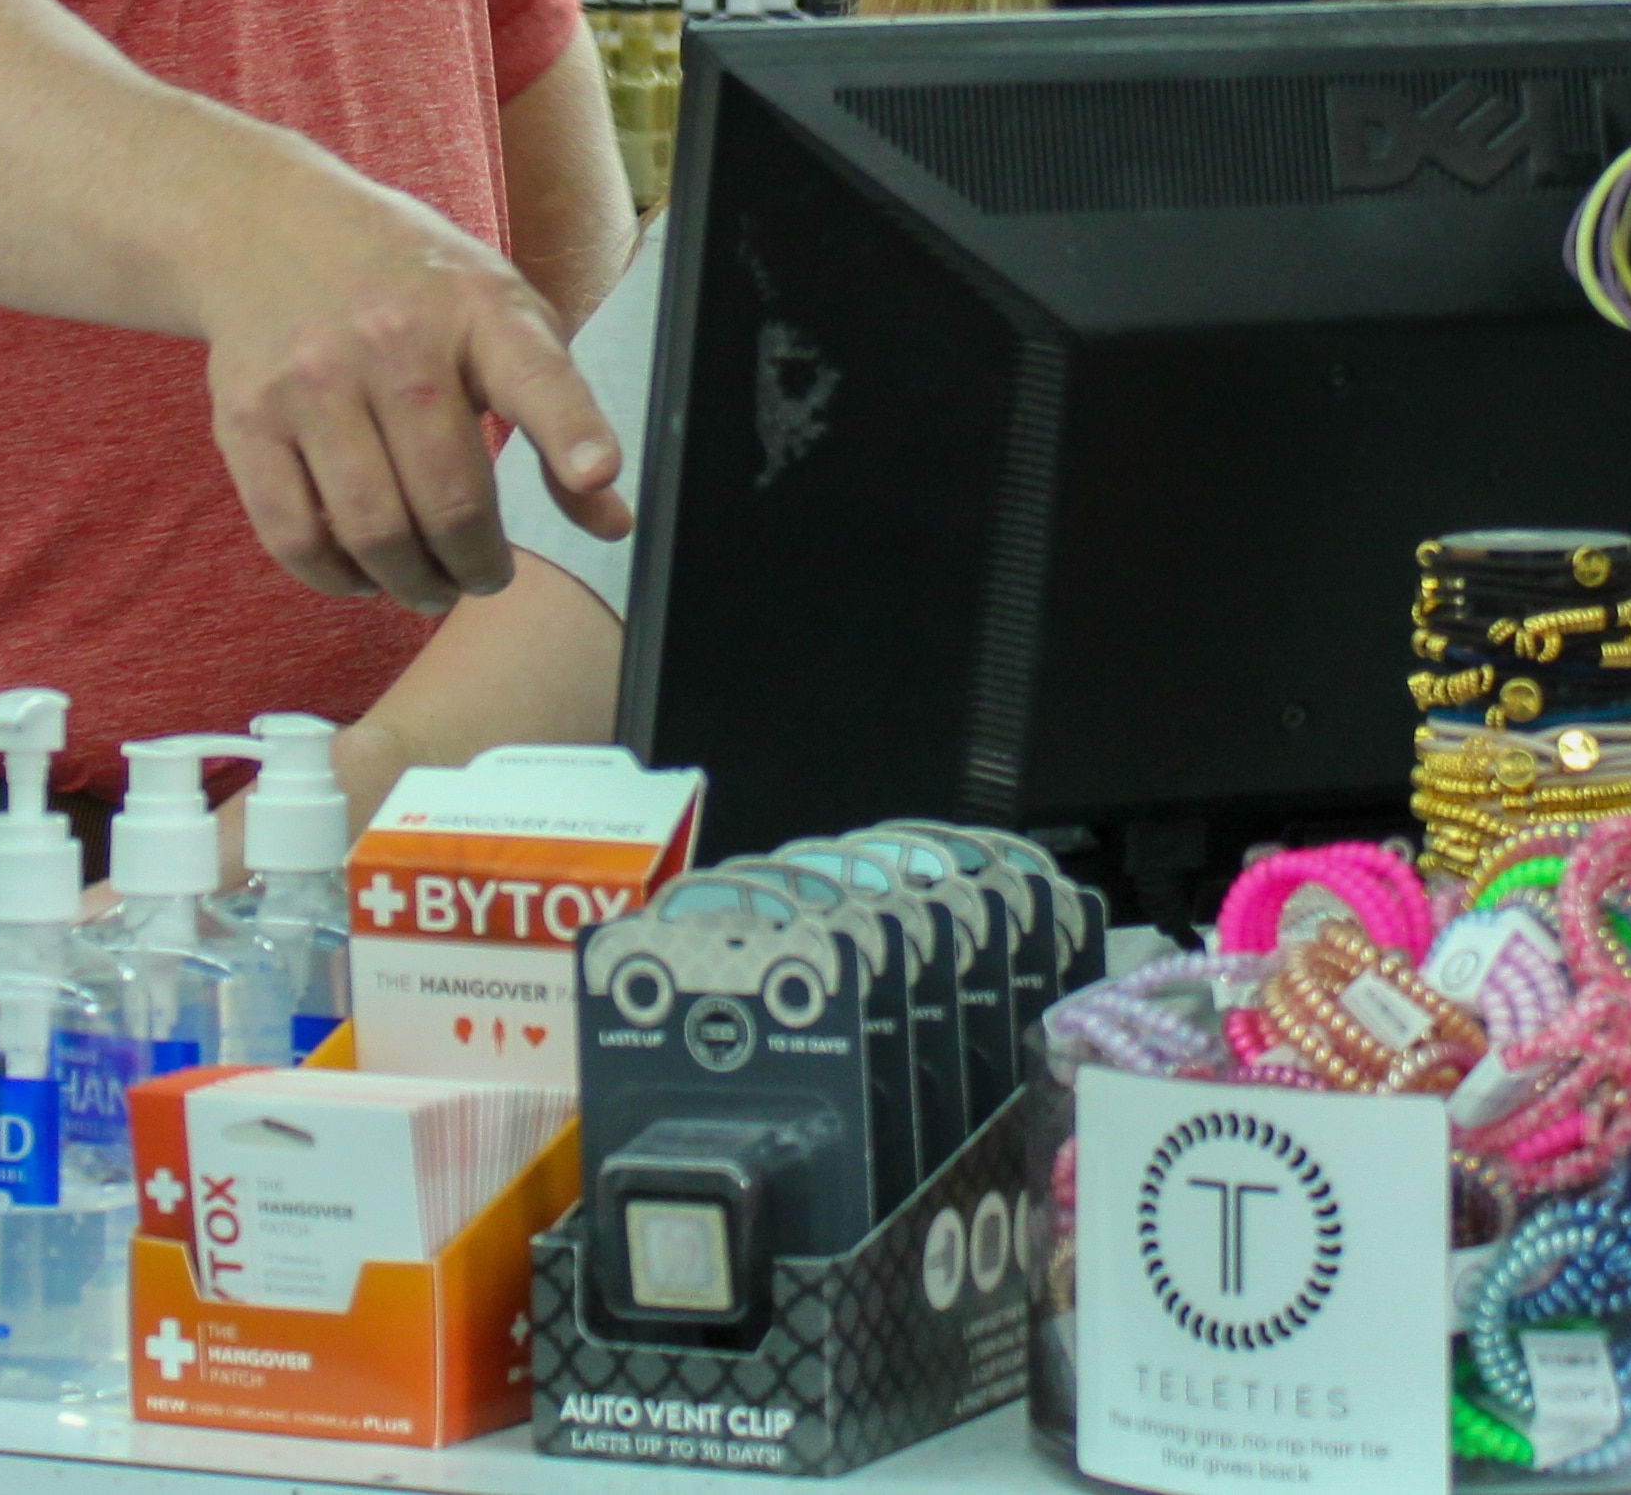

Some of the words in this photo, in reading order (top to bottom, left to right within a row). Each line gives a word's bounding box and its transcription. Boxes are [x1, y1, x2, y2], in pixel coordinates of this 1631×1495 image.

[375, 972, 411, 993] THE
[419, 978, 548, 1001] HANGOVER
[598, 1029, 642, 1048] LASTS
[644, 1030, 665, 1047] UP
[258, 1201, 354, 1220] HANGOVER
[201, 1174, 246, 1303] TOX
[1187, 1178, 1280, 1298] T
[207, 1321, 237, 1341] THE
[208, 1347, 312, 1372] HANGOVER
[1136, 1363, 1349, 1421] TELETIES
[146, 1396, 187, 1414] NEW
[362, 1417, 412, 1434] PLUS
[560, 1392, 643, 1428] AUTO
[643, 1398, 723, 1434] VENT
[726, 1405, 796, 1439] CLIP
[570, 1429, 630, 1455] LASTS
[634, 1434, 664, 1456] UP
[668, 1437, 695, 1459] TO
[699, 1439, 724, 1461] 30
[726, 1441, 784, 1467] DAYS!
